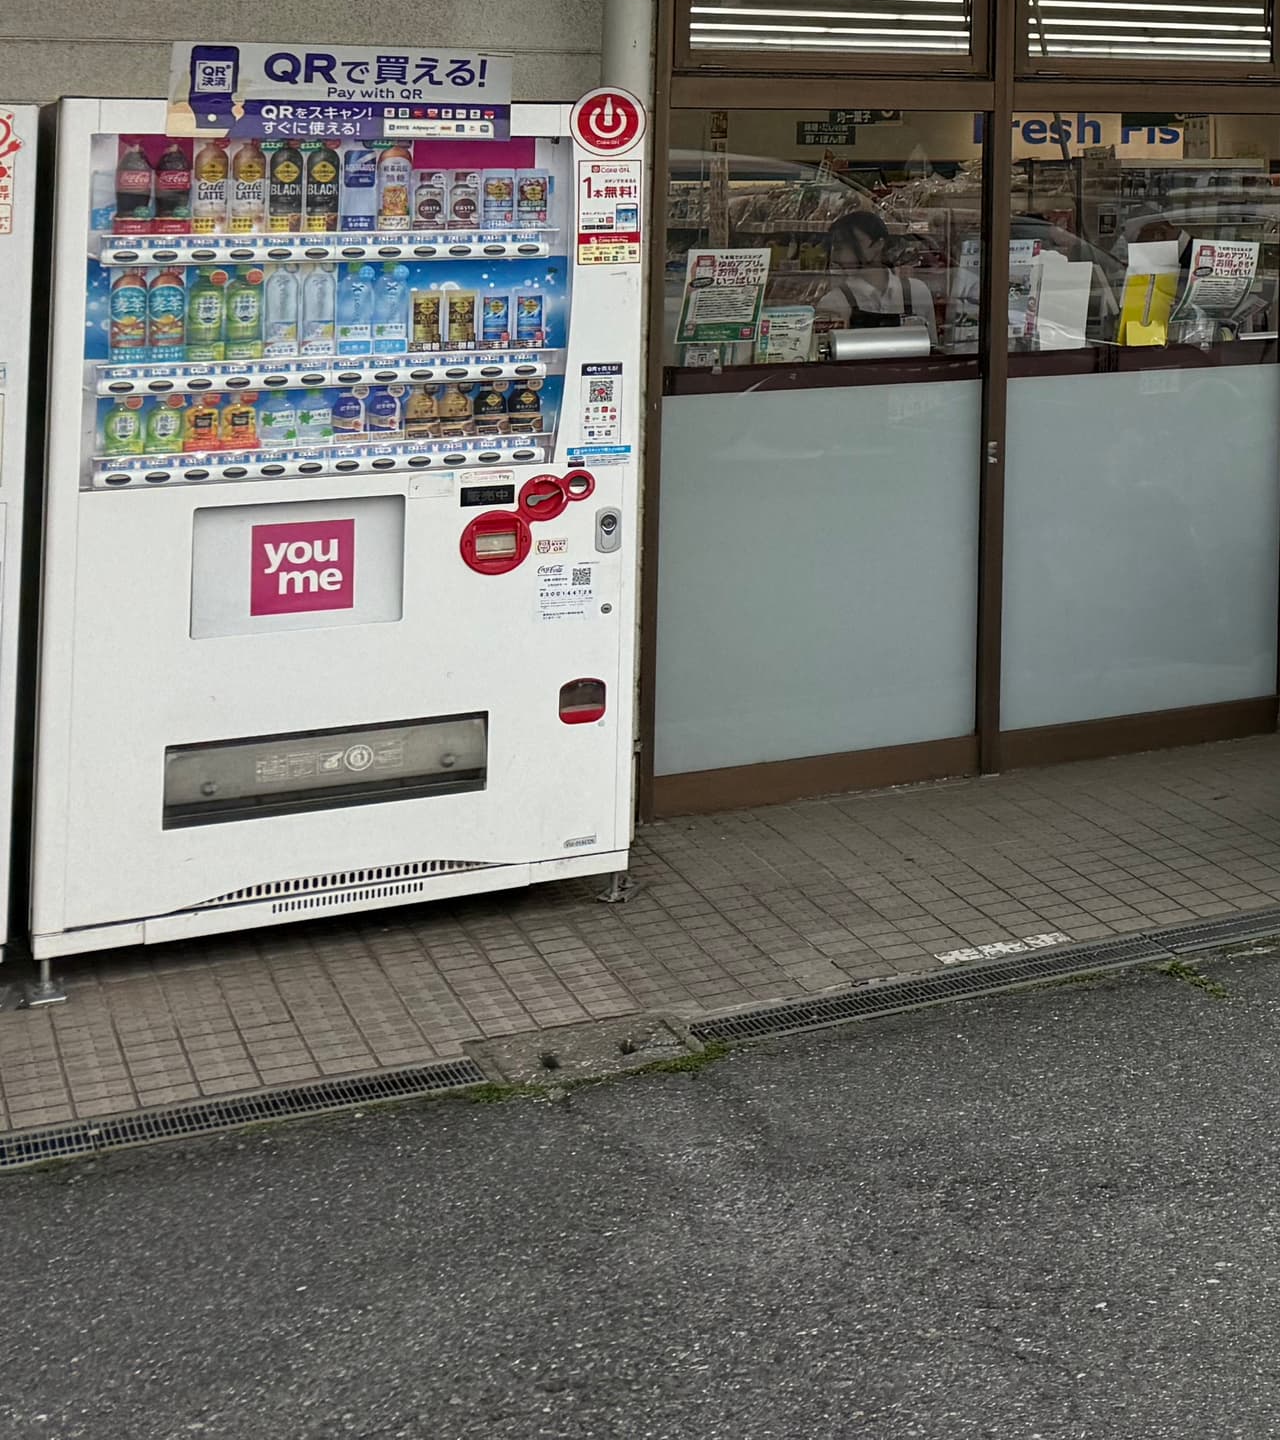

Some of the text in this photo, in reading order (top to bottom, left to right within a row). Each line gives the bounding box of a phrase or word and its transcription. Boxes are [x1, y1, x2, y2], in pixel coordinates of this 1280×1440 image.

[263, 52, 488, 88] QRで買える!
[327, 86, 423, 100] Pay with QR
[261, 104, 372, 121] QRをスキャン!
[262, 122, 360, 136] すぐに使える!
[198, 180, 225, 191] Café
[236, 180, 262, 191] Café
[271, 184, 302, 196] BLACK
[308, 183, 338, 195] BLACK
[197, 191, 225, 201] LATTE
[235, 191, 262, 201] LATTE
[114, 297, 145, 312] 麦茶
[152, 296, 183, 311] 麦茶
[263, 537, 339, 574] you
[277, 566, 343, 595] me
